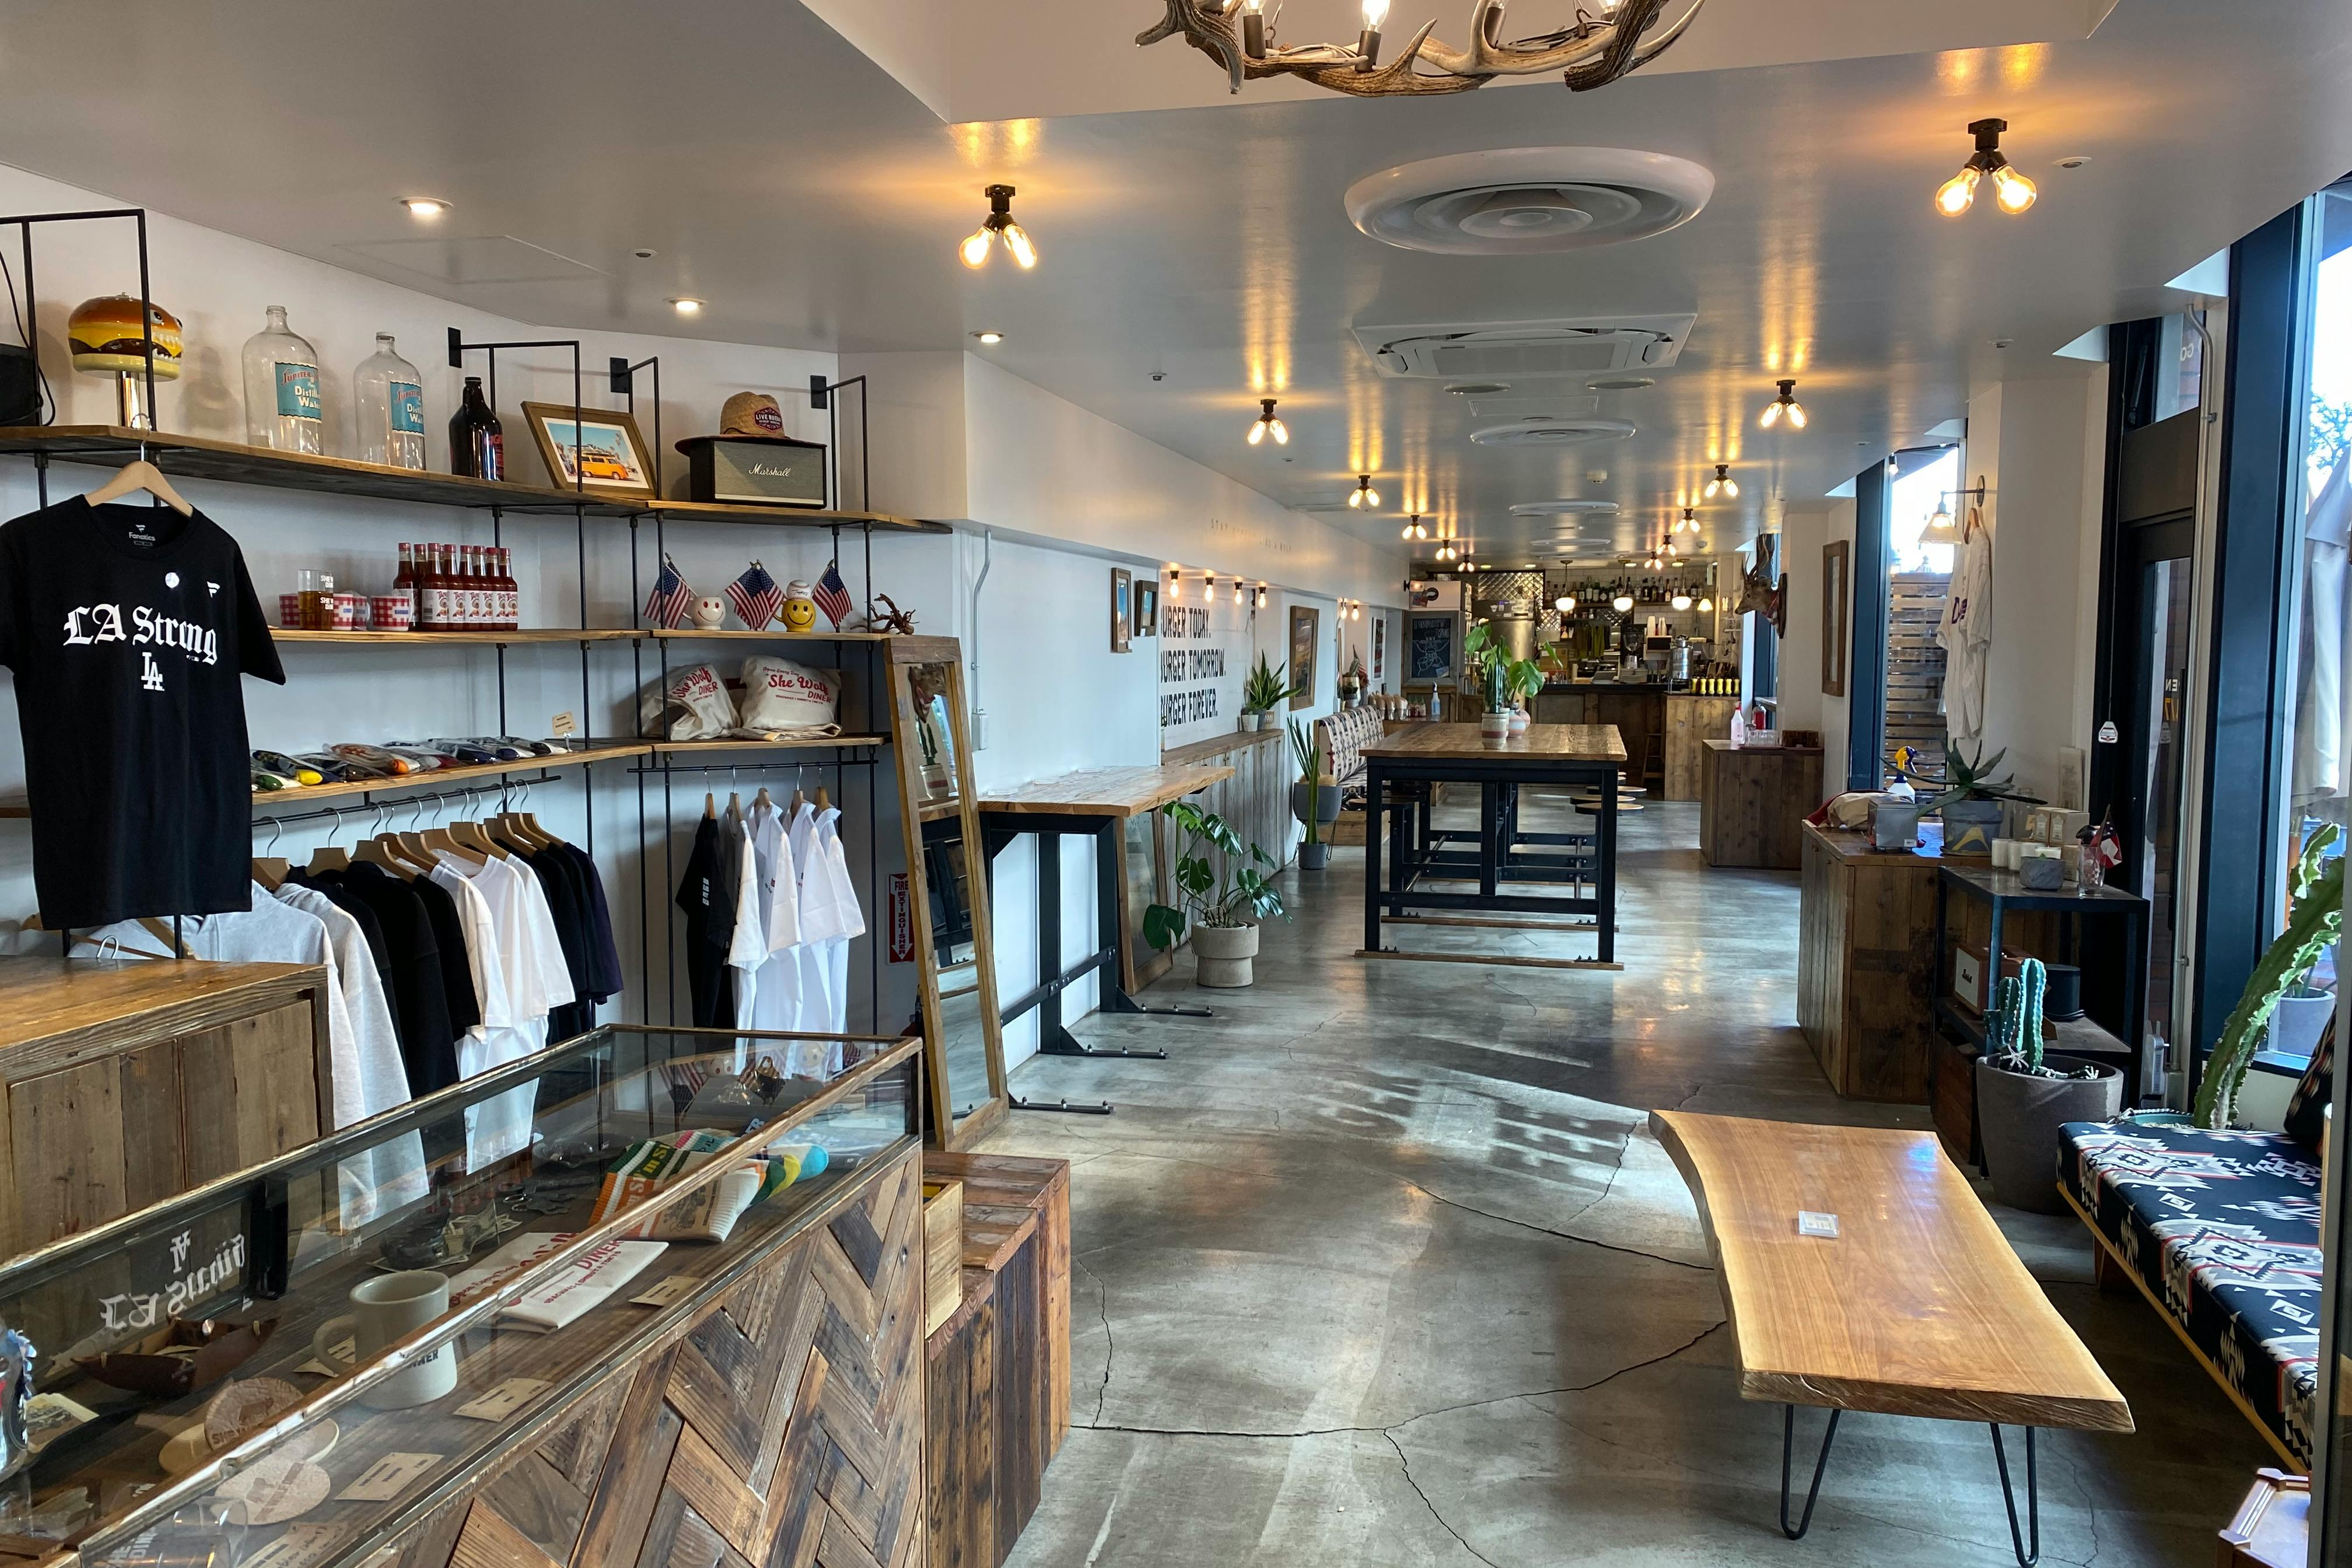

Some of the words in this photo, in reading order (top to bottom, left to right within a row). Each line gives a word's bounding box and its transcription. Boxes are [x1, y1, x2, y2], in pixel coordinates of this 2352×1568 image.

[748, 463, 791, 477] Marshall
[129, 531, 155, 541] Fanatics
[63, 604, 127, 645] LA
[1161, 605, 1186, 638] URGER
[1189, 607, 1211, 639] TODAY.
[141, 652, 164, 691] LA
[1161, 650, 1186, 683] URGER
[1189, 648, 1226, 680] TOMORROW.
[673, 682, 691, 698] She
[685, 667, 712, 687] Wolf
[699, 681, 718, 695] DINER
[768, 674, 794, 688] She
[797, 676, 830, 695] Wolf
[807, 691, 831, 704] DINER
[1189, 688, 1218, 722] FOREVER.
[895, 880, 908, 891] FIRE
